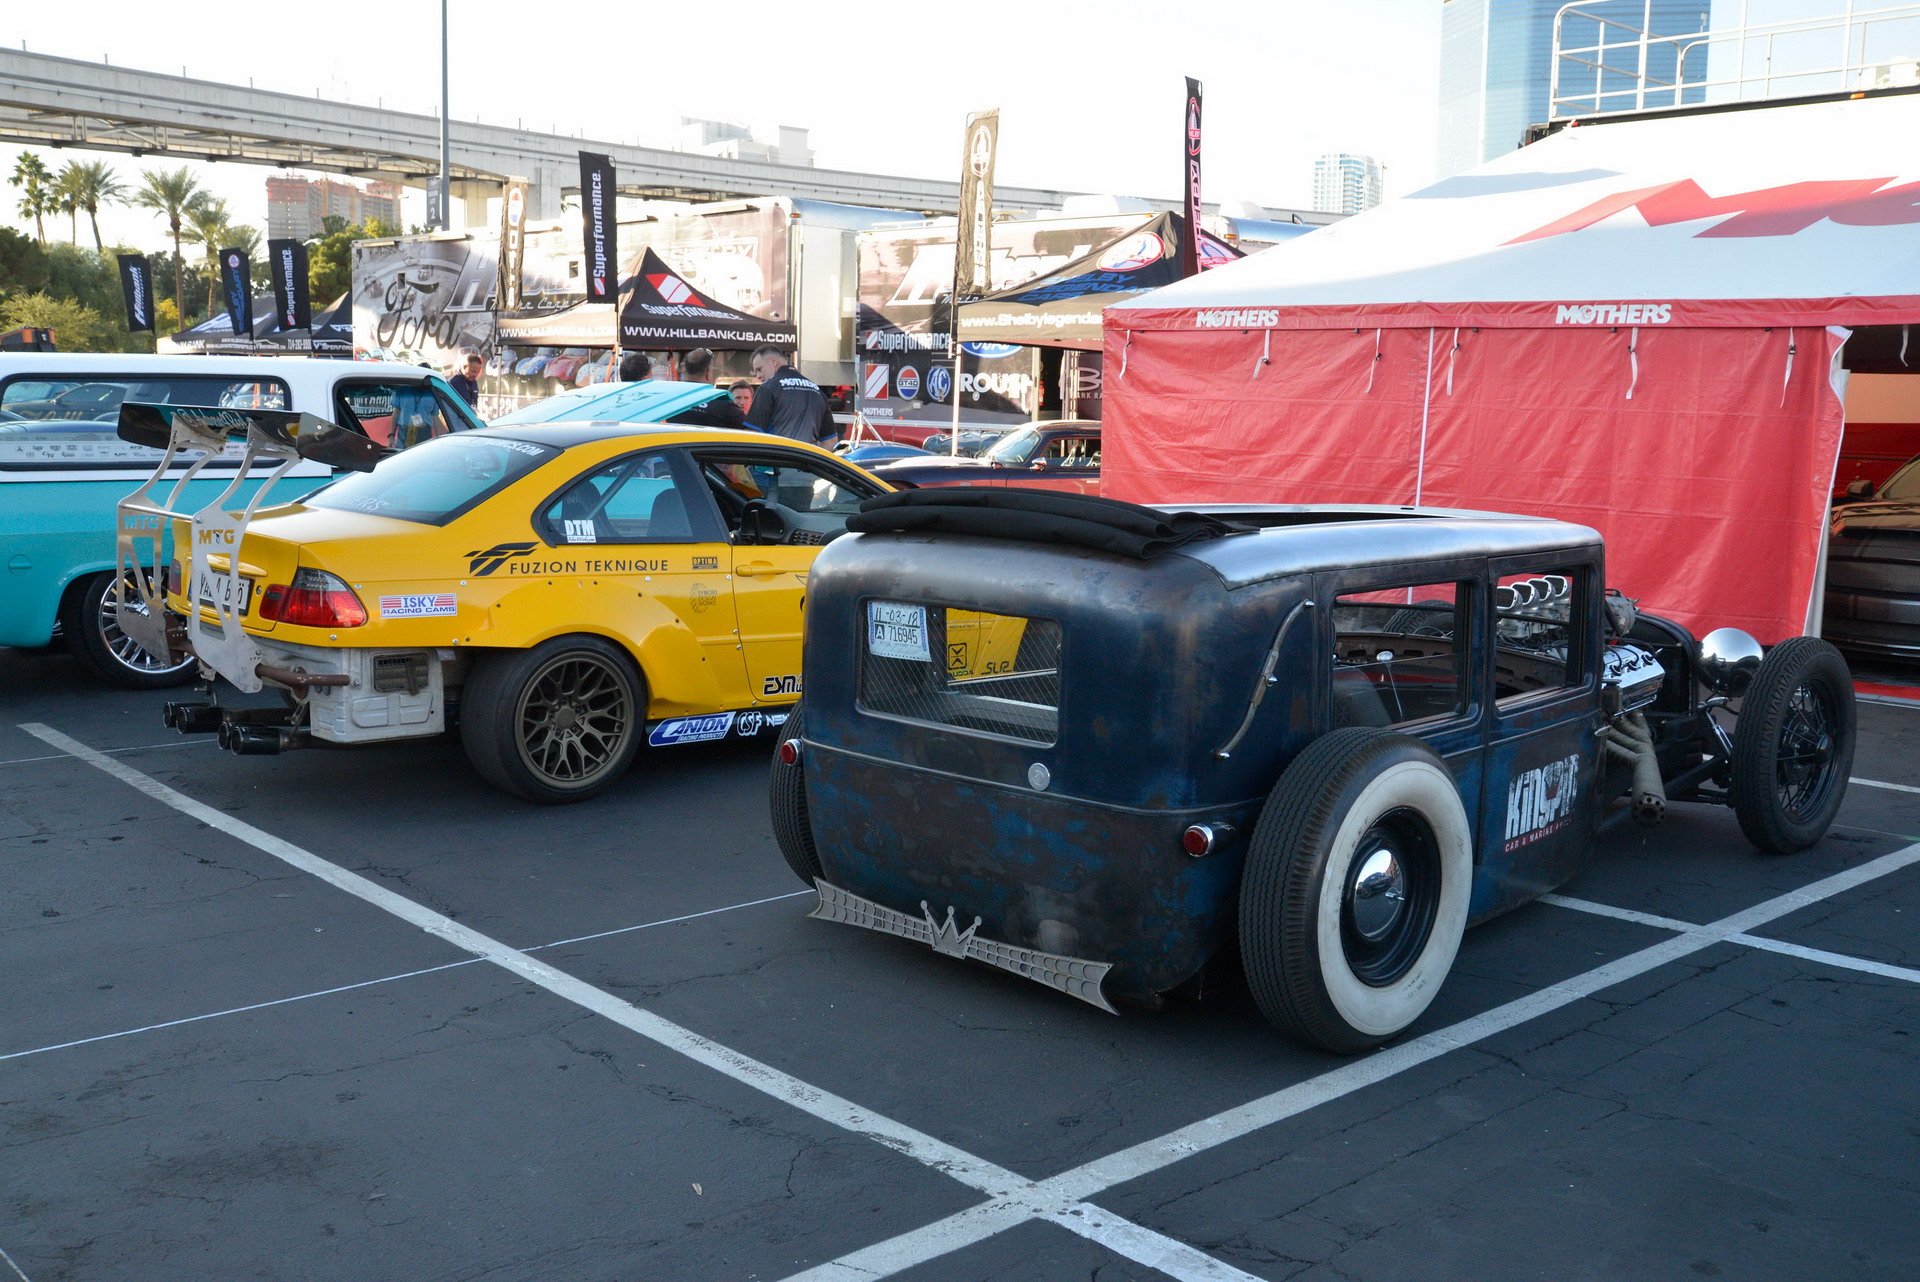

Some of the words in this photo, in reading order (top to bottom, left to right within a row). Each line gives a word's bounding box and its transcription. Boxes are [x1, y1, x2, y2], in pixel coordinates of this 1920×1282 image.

[430, 206, 436, 220] 2
[592, 172, 606, 278] Superformance
[282, 248, 296, 315] Superformance
[129, 264, 147, 327] Hillbank
[377, 281, 460, 349] Ford
[641, 303, 744, 320] Superformance
[1195, 308, 1280, 329] MOTHERS
[1555, 303, 1672, 325] MOTHERS
[624, 326, 796, 344] WWW.HILLBANKUSA.COM
[877, 330, 950, 352] Superformance
[779, 377, 820, 391] MOTHERS
[863, 407, 893, 416] MOTHERS
[123, 514, 159, 530] MTG
[564, 519, 596, 536] DTM
[199, 529, 235, 545] MTG
[509, 560, 577, 575] FUZION
[585, 559, 669, 573] TEKNIQUE
[383, 607, 422, 615] RACING
[402, 596, 436, 609] ISKY
[888, 625, 918, 645] 716945
[737, 711, 762, 736] CSF
[678, 734, 699, 743] RACING
[699, 731, 725, 740] PRODUCTS
[1505, 840, 1519, 853] CAR
[1529, 825, 1553, 842] MARINE
